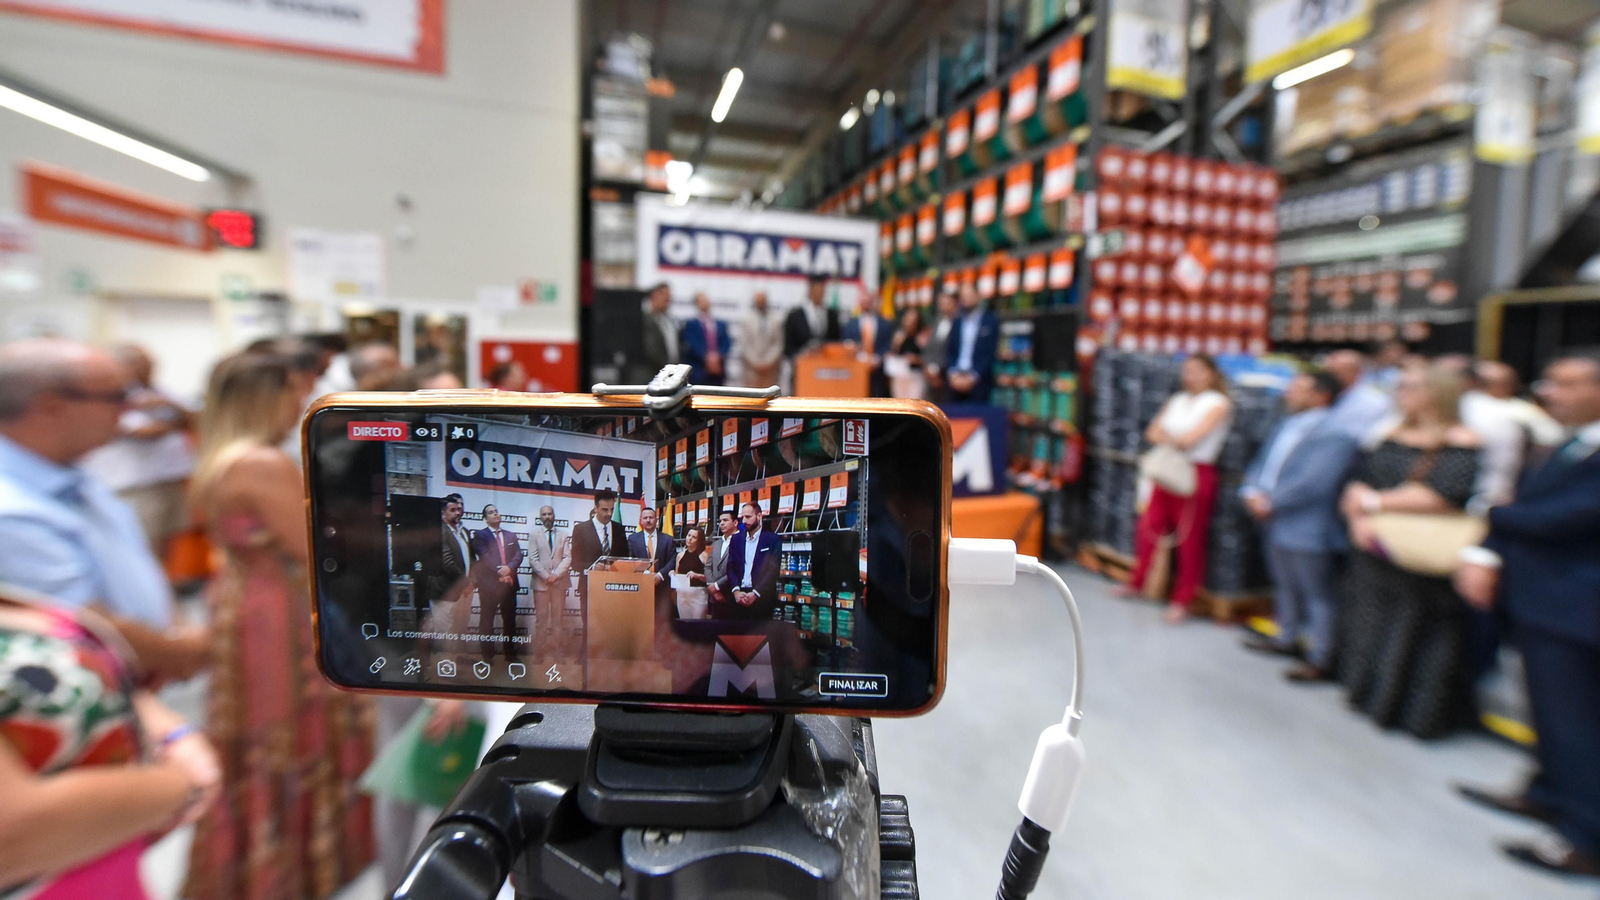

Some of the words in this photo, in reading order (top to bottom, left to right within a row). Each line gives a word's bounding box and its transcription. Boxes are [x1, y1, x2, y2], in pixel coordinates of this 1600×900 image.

[661, 229, 860, 277] OBRAMAT
[352, 426, 402, 438] DIRECTO
[430, 427, 438, 438] 8
[466, 428, 474, 439] 0
[451, 447, 639, 494] OBRAMAT
[387, 628, 403, 638] Los
[404, 630, 458, 641] comentarios
[460, 631, 510, 643] aparecerán
[512, 634, 532, 645] aquí
[828, 678, 879, 691] FINALIZAR
